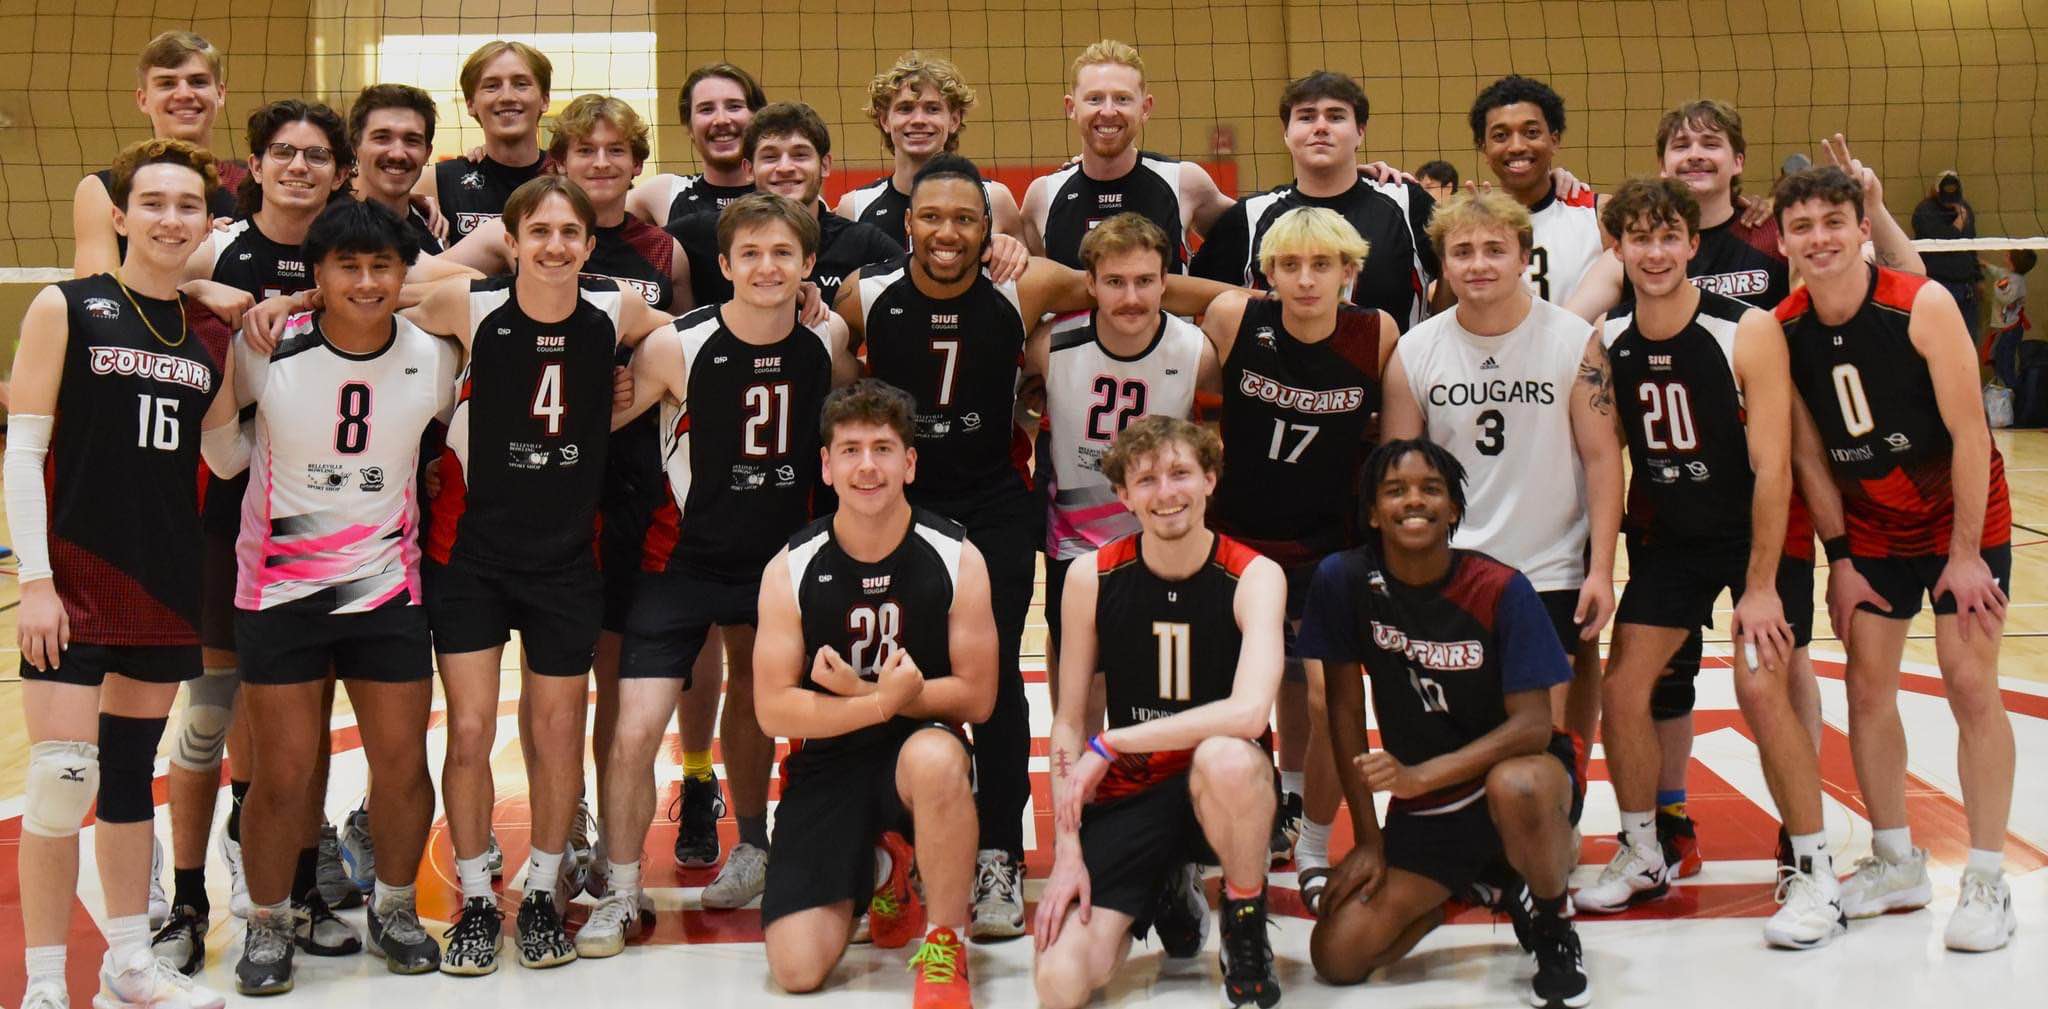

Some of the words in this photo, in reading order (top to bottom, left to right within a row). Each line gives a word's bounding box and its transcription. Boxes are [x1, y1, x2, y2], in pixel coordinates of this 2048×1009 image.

[1098, 194, 1122, 203] SIUE
[278, 260, 305, 271] SIUE
[537, 336, 565, 346] SIUE
[931, 315, 959, 324] SIUE
[89, 346, 211, 394] COUGARS
[754, 357, 782, 368] SIUE
[932, 340, 959, 406] 7
[1648, 355, 1672, 365] SIUE
[532, 363, 566, 435] 4
[1085, 374, 1148, 442] 22
[1240, 369, 1364, 414] COUGARS
[1429, 380, 1555, 407] COUGARS
[1832, 363, 1875, 438] 0
[137, 394, 180, 451] 16
[333, 380, 374, 456] 8
[744, 384, 790, 456] 21
[1475, 409, 1505, 456] 3
[1639, 382, 1697, 450] 20
[1268, 418, 1320, 464] 17
[862, 576, 891, 589] SIUE
[850, 602, 900, 677] 28
[1152, 621, 1191, 701] 11
